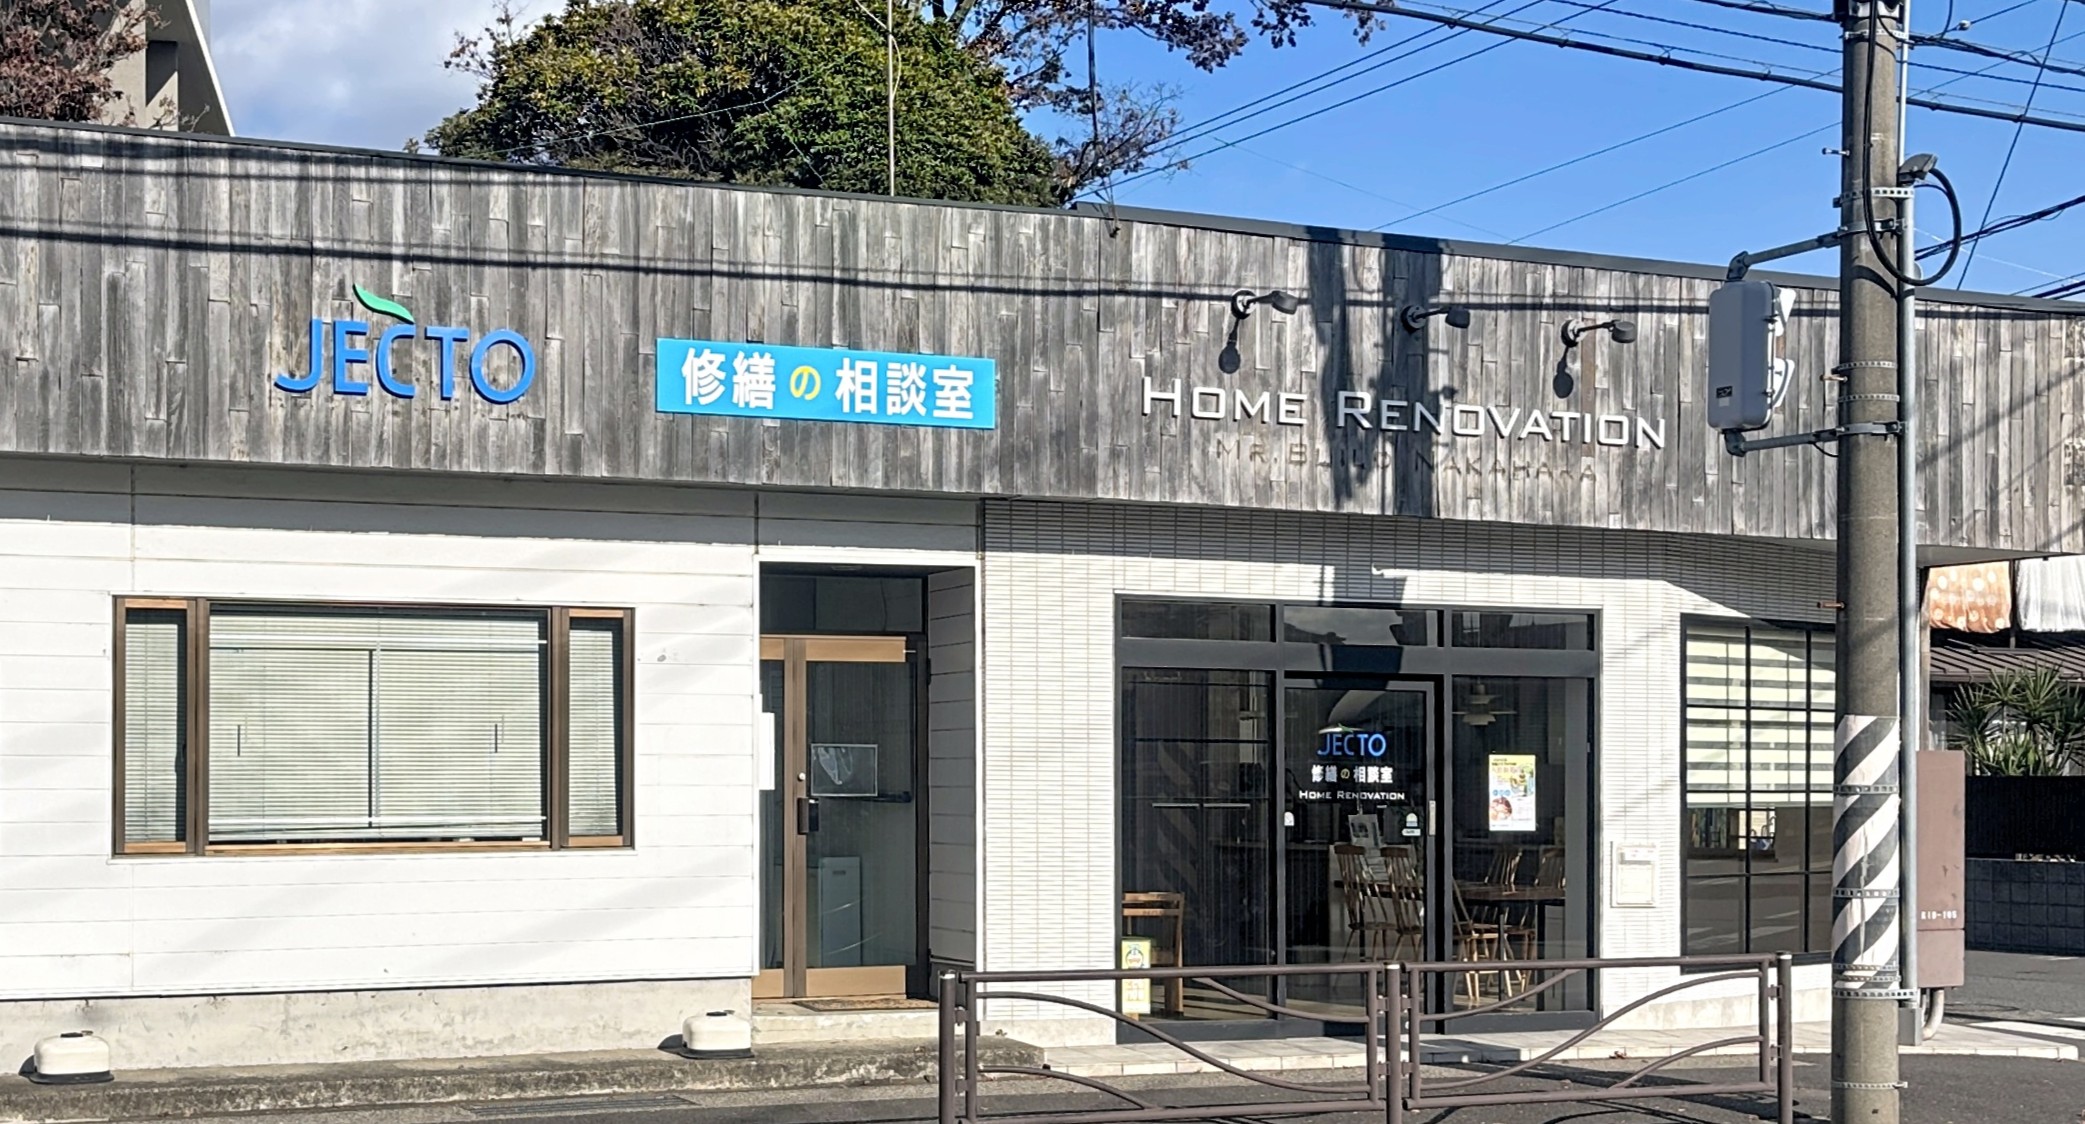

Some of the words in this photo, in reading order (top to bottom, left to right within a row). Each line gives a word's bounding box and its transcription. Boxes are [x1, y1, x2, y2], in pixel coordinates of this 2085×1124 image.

[274, 317, 536, 404] JECTO
[681, 347, 974, 420] 修繕の相談室
[1142, 376, 1308, 425] HOME
[1336, 390, 1666, 449] RENOVATION
[1317, 733, 1387, 757] JECTO
[1299, 790, 1332, 800] HOME
[1336, 790, 1405, 801] RENOVATION
[1311, 764, 1393, 784] 修繕の相談室
